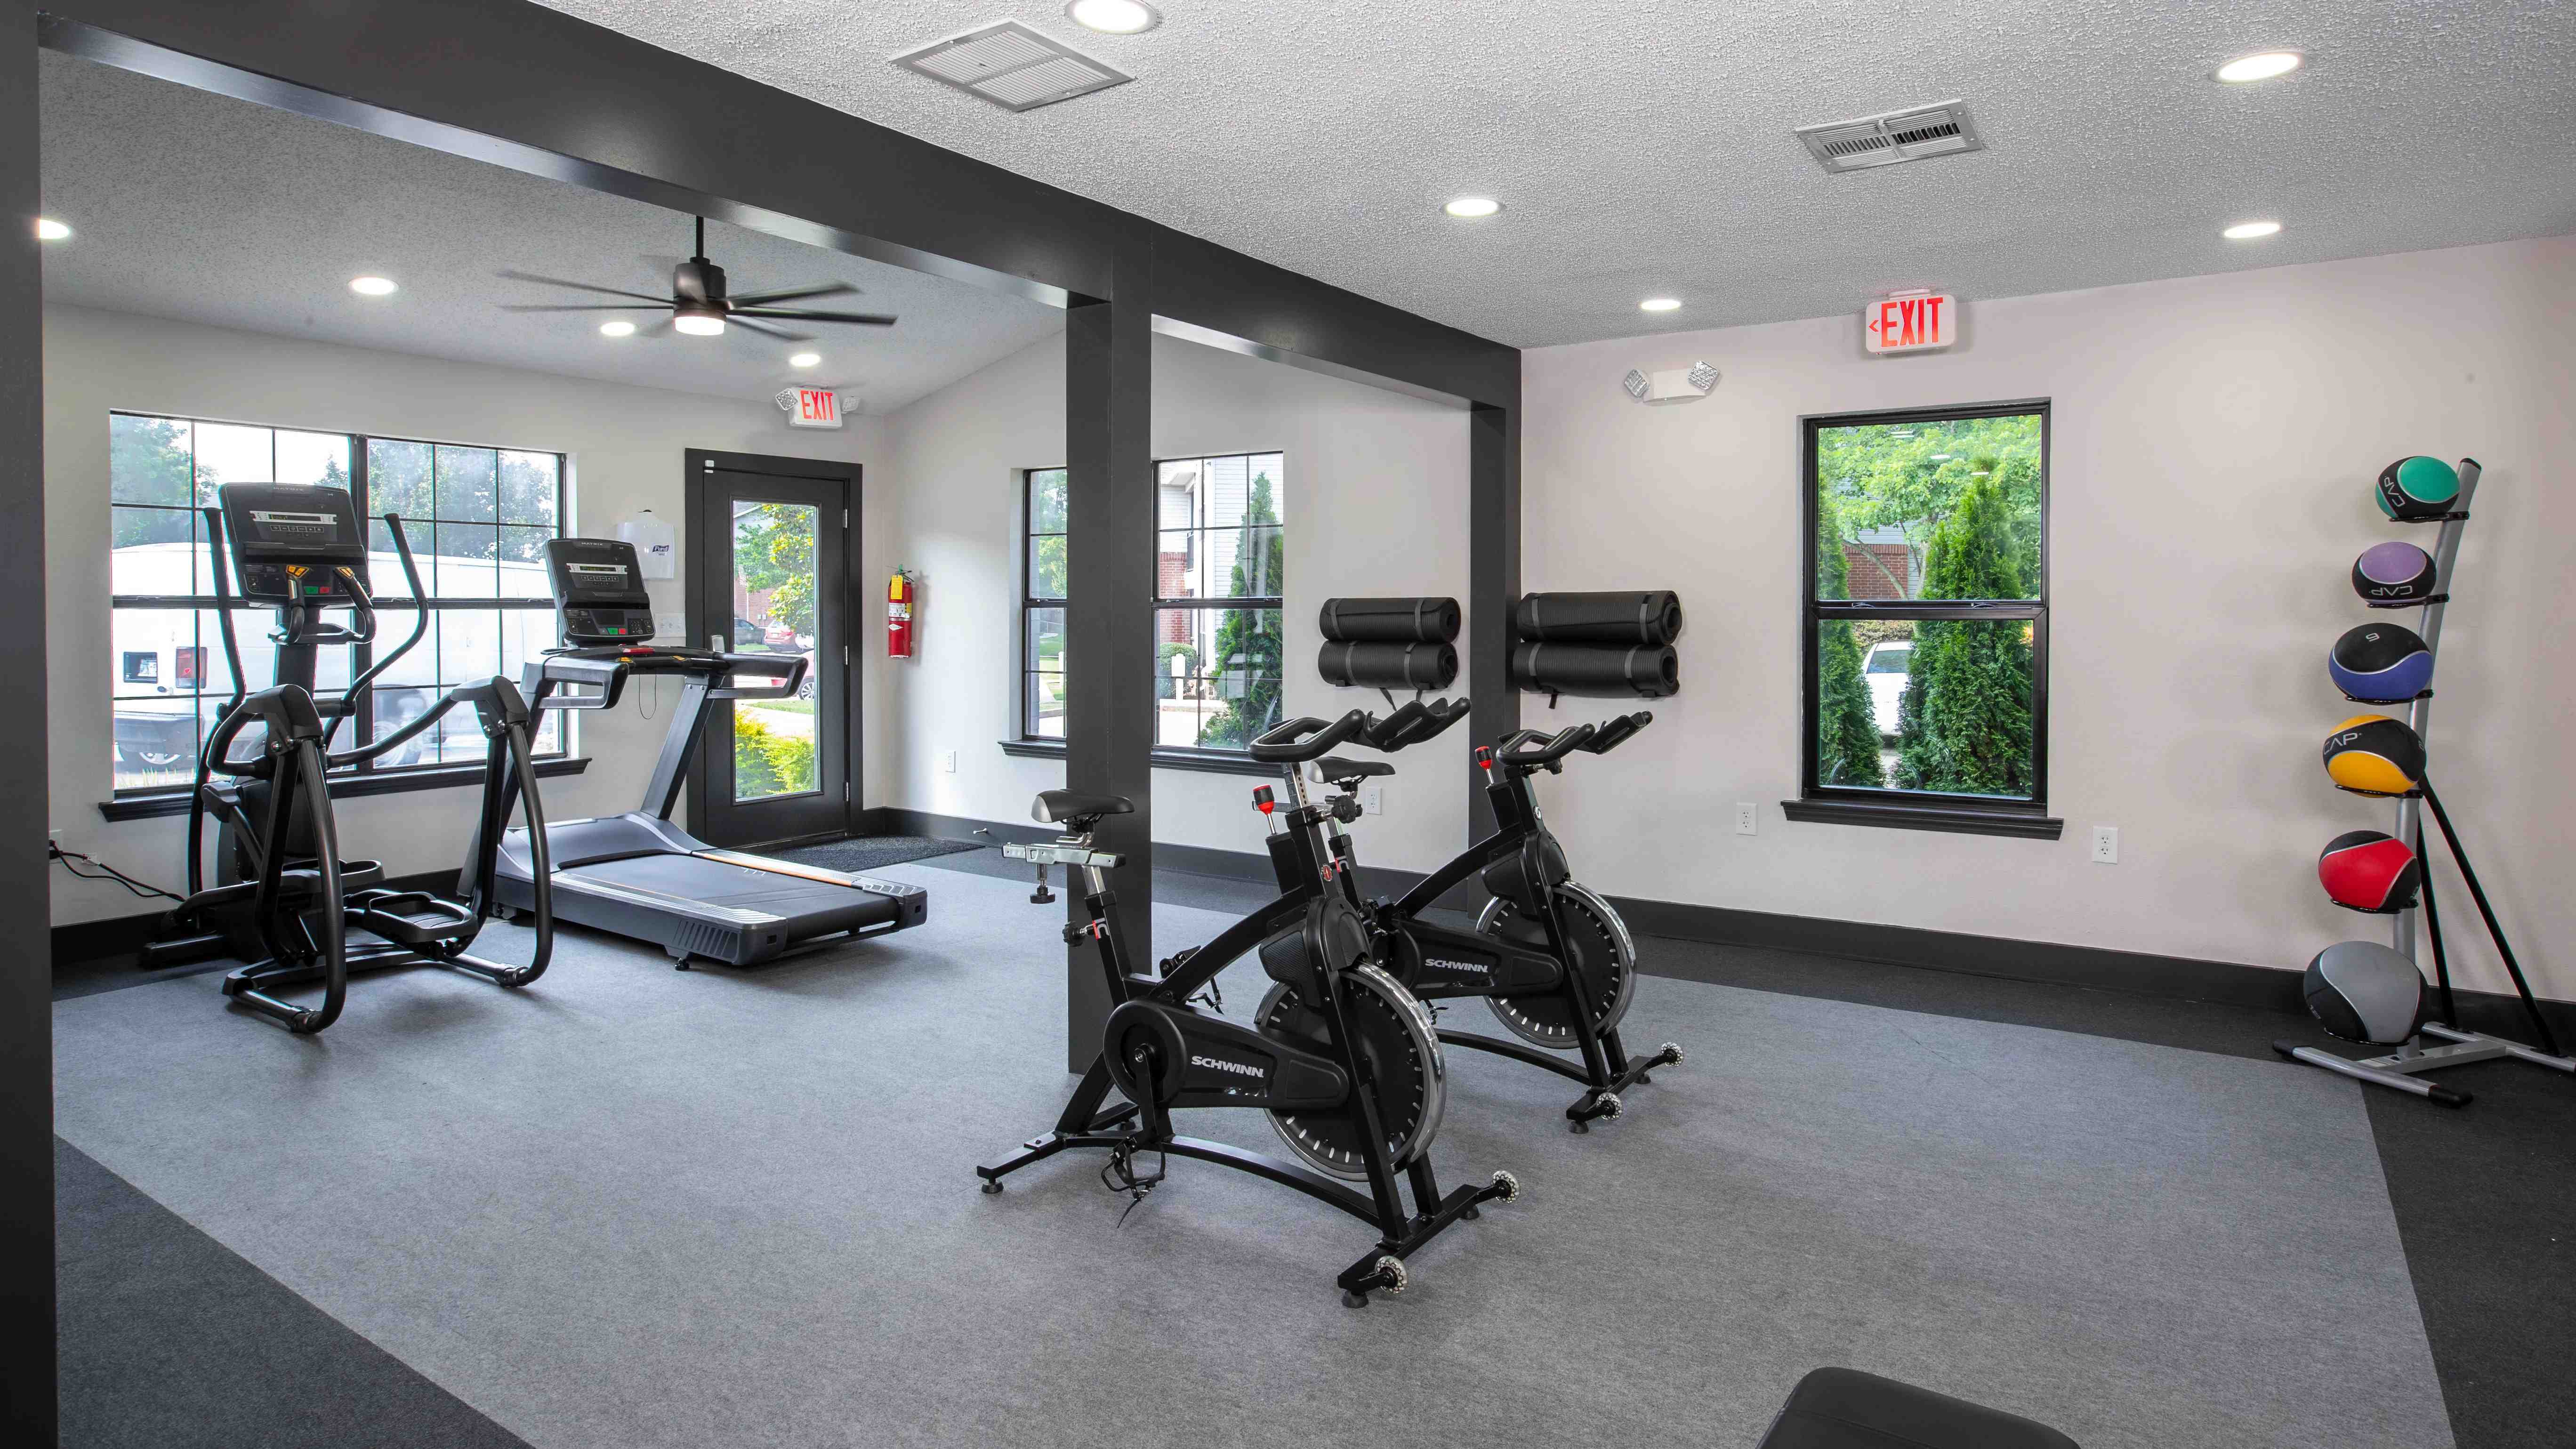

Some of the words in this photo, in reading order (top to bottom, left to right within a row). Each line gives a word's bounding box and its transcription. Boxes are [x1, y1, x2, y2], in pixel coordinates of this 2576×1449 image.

[1881, 297, 1943, 347] EXIT
[800, 390, 834, 421] EXIT
[2384, 477, 2406, 507] CAP
[2371, 585, 2413, 596] CAP
[2324, 733, 2358, 755] CAP
[1425, 959, 1488, 973] SCHWINN
[1191, 1056, 1264, 1078] SCHWINN
